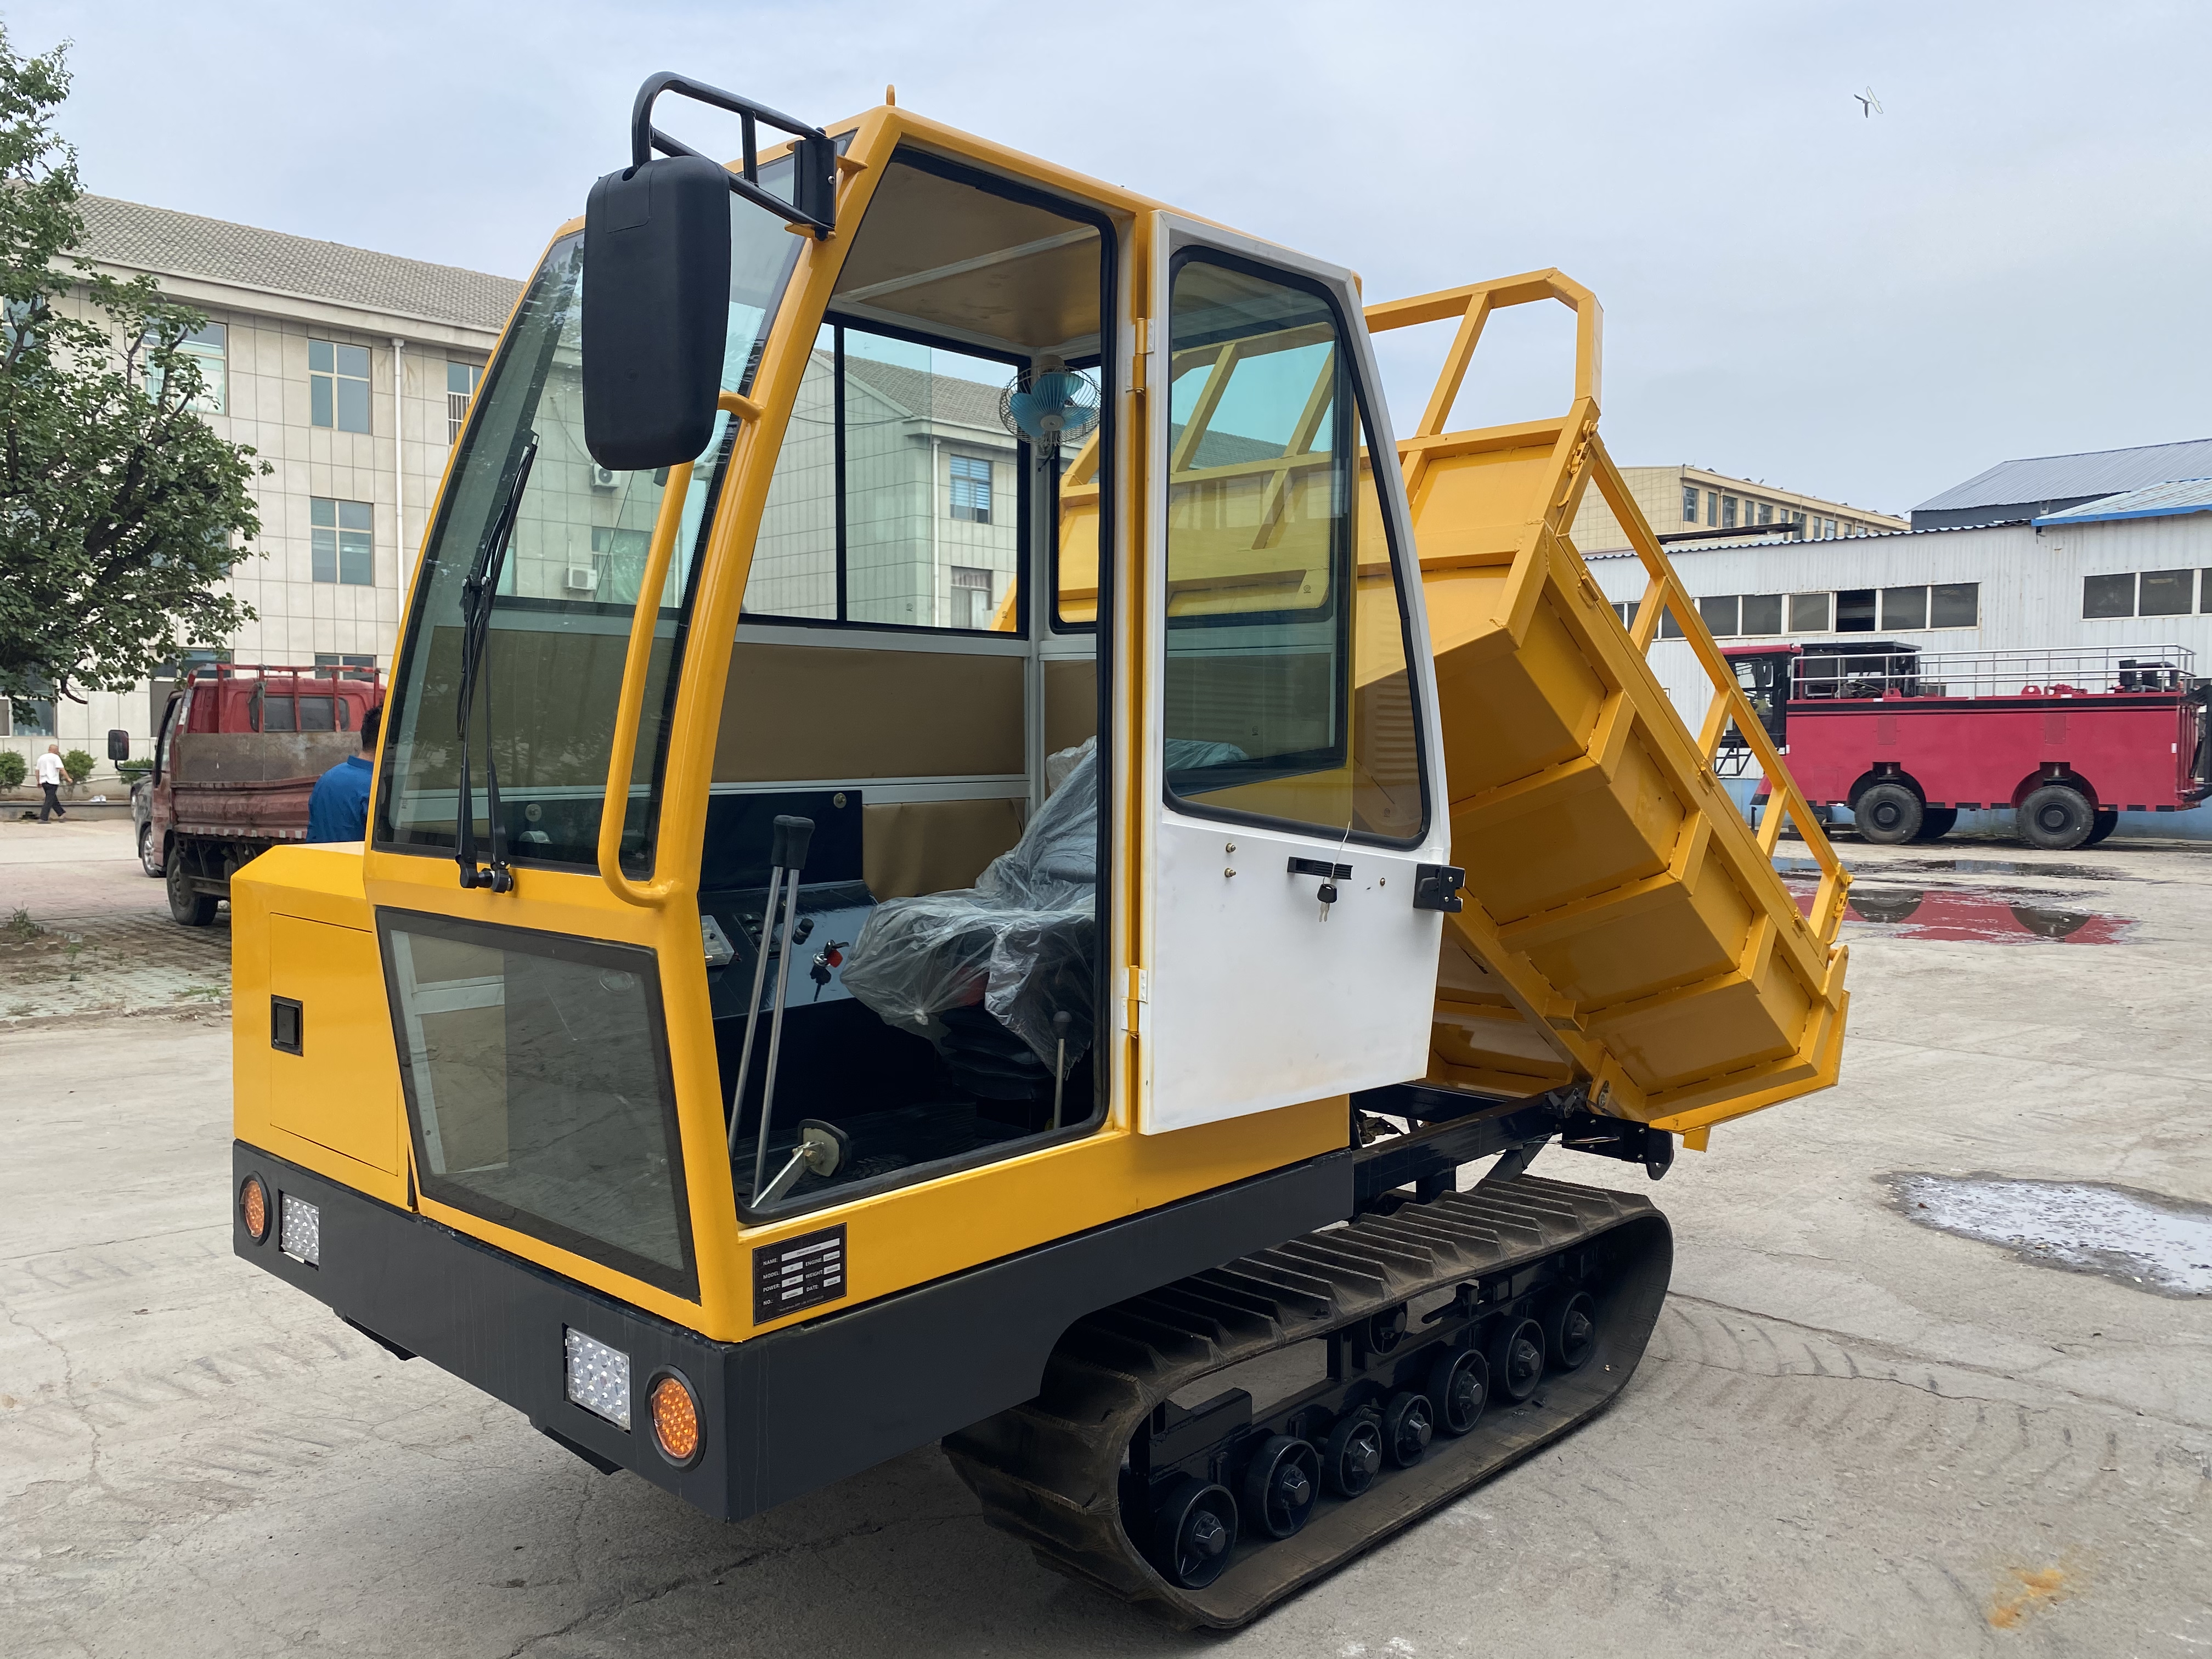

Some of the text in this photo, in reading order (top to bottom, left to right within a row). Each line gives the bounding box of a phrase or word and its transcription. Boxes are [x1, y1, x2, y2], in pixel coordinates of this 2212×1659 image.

[805, 1258, 822, 1266] ENGINE:
[763, 1271, 780, 1279] MODEL:
[805, 1270, 823, 1279] WEIGHT:
[763, 1284, 780, 1292] POWER:
